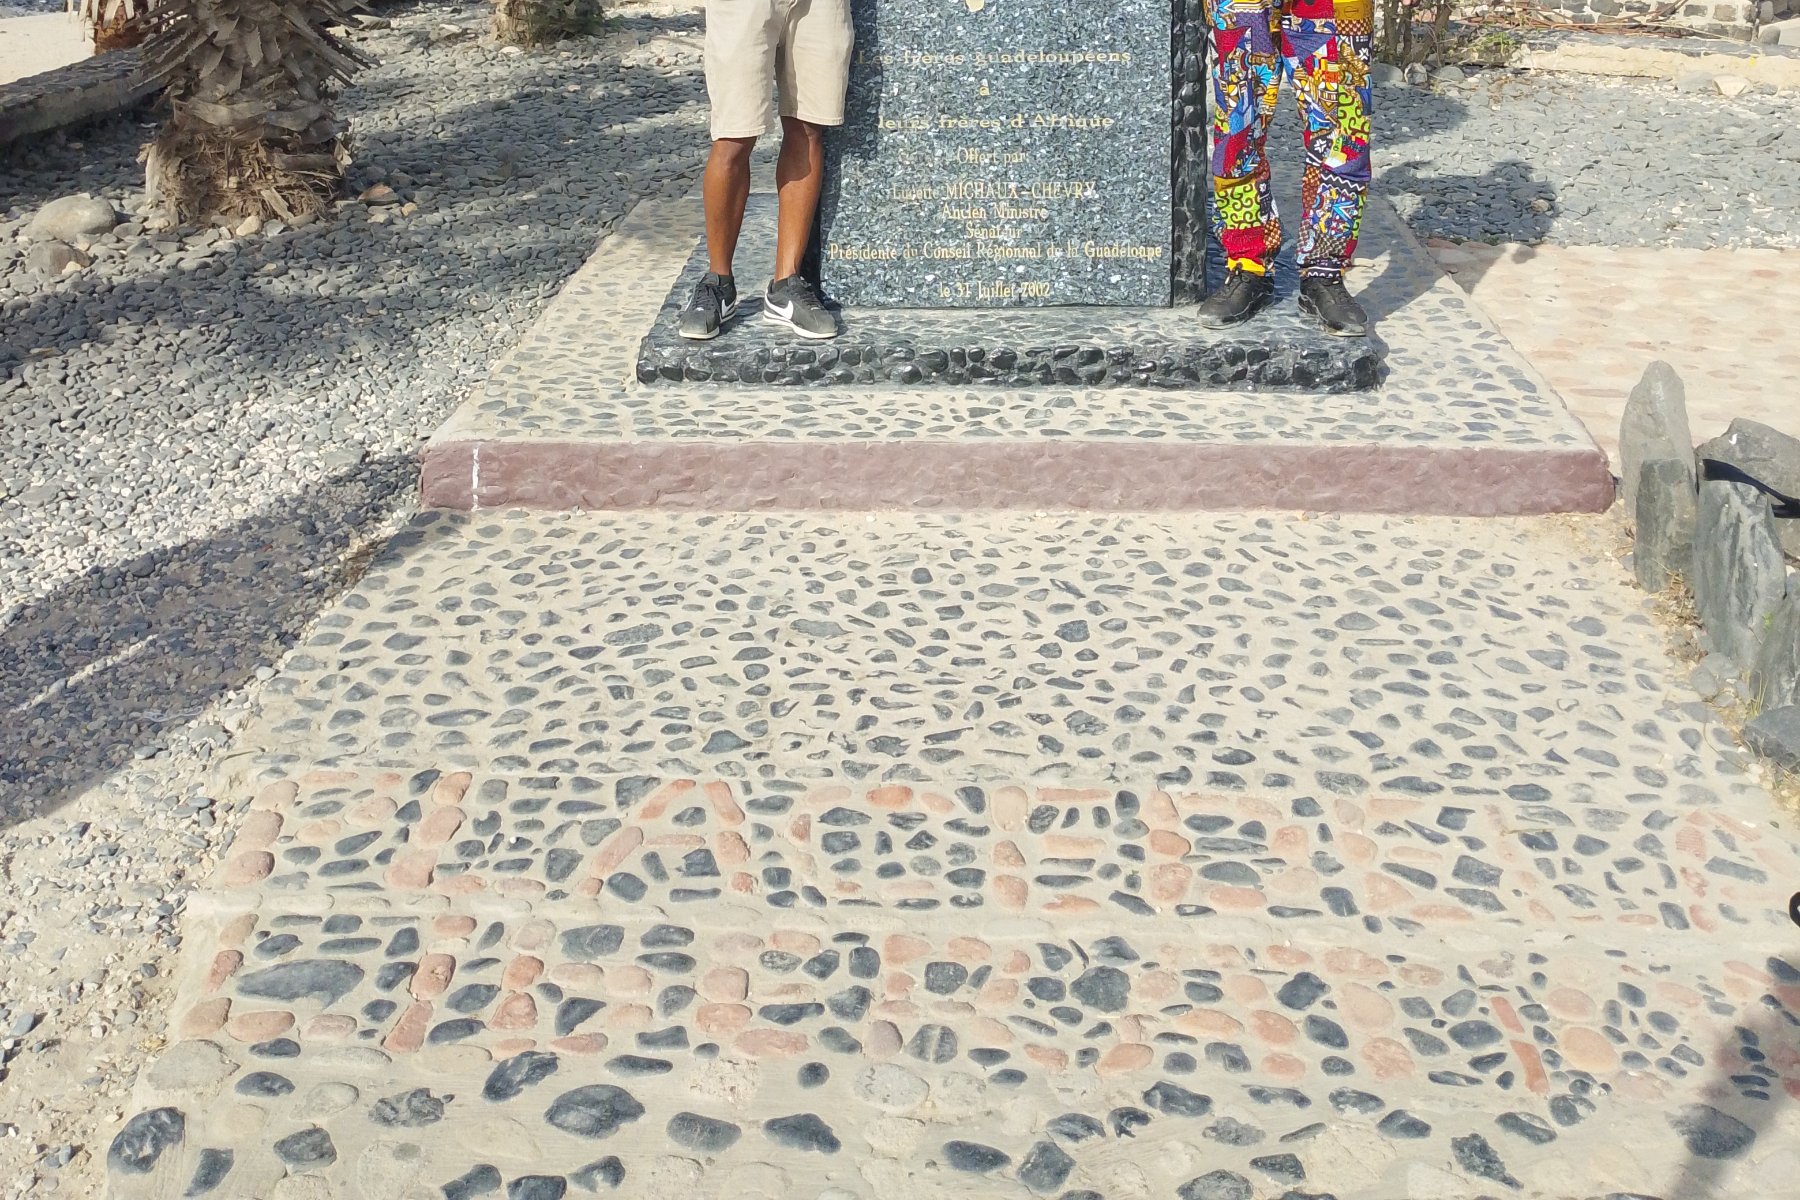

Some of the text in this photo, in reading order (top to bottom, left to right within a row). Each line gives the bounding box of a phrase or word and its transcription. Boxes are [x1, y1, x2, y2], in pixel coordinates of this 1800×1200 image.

[903, 242, 918, 259] du
[923, 241, 972, 259] Conseil
[1085, 240, 1162, 261] Guadeloupe
